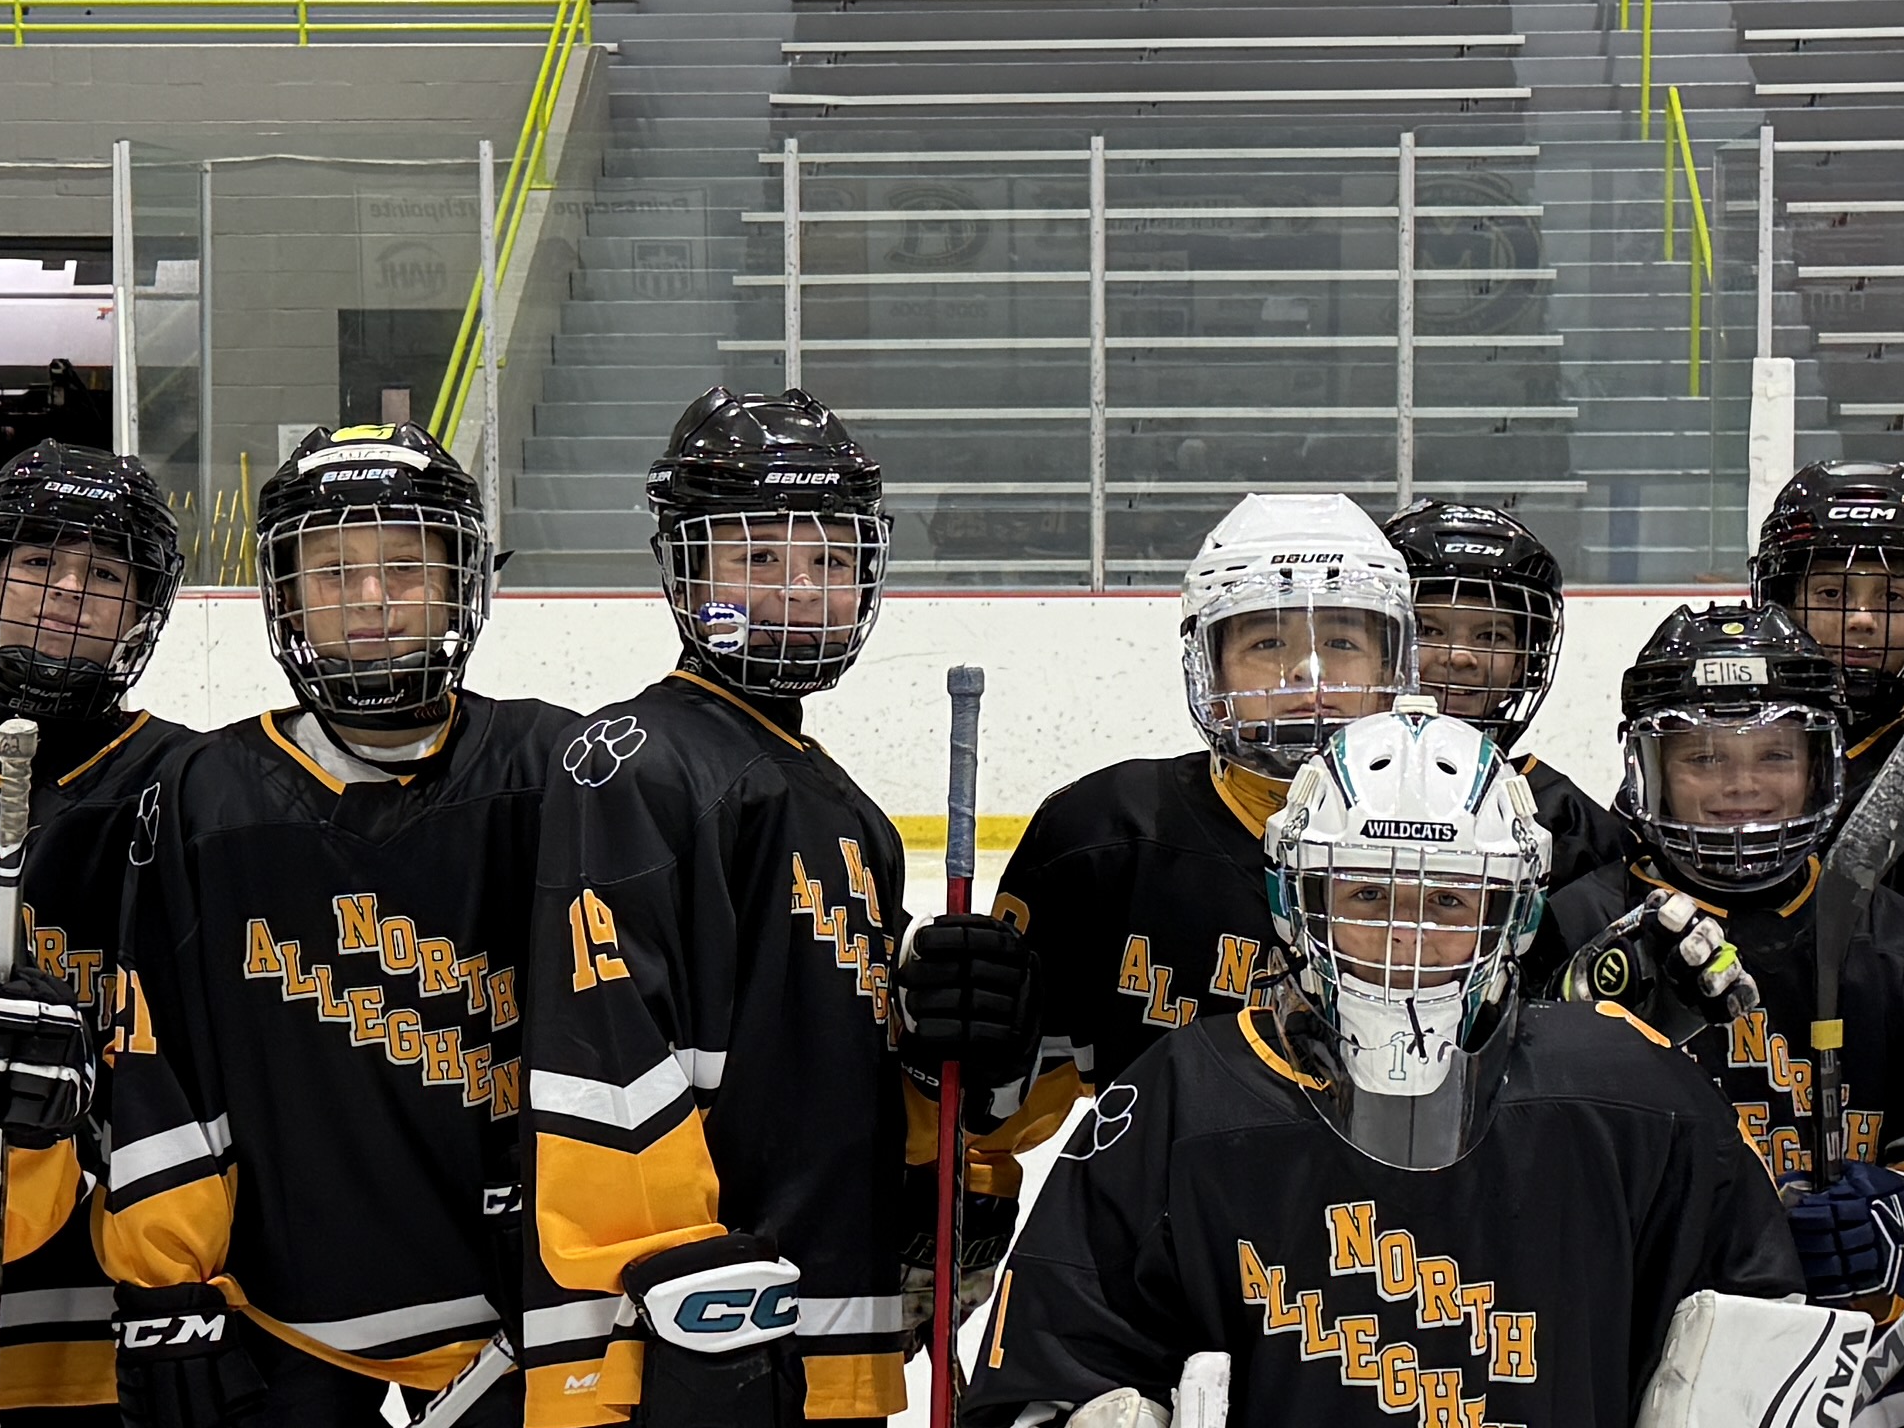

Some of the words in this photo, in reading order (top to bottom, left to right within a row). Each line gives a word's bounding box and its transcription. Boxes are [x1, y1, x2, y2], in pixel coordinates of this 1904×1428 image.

[321, 468, 398, 483] BAUER
[765, 470, 842, 486] BAUER
[1826, 504, 1896, 521] CCM
[1270, 552, 1345, 566] BAUER
[1443, 543, 1506, 559] CCM
[1702, 658, 1752, 685] Ellis
[1367, 821, 1455, 841] WILDCATS
[567, 888, 631, 993] 19
[332, 893, 520, 1033] NORTH
[244, 918, 522, 1122] ALLEGHEN
[1386, 1032, 1407, 1081] 1
[1324, 1200, 1538, 1384] NORTH
[672, 1288, 802, 1334] CC
